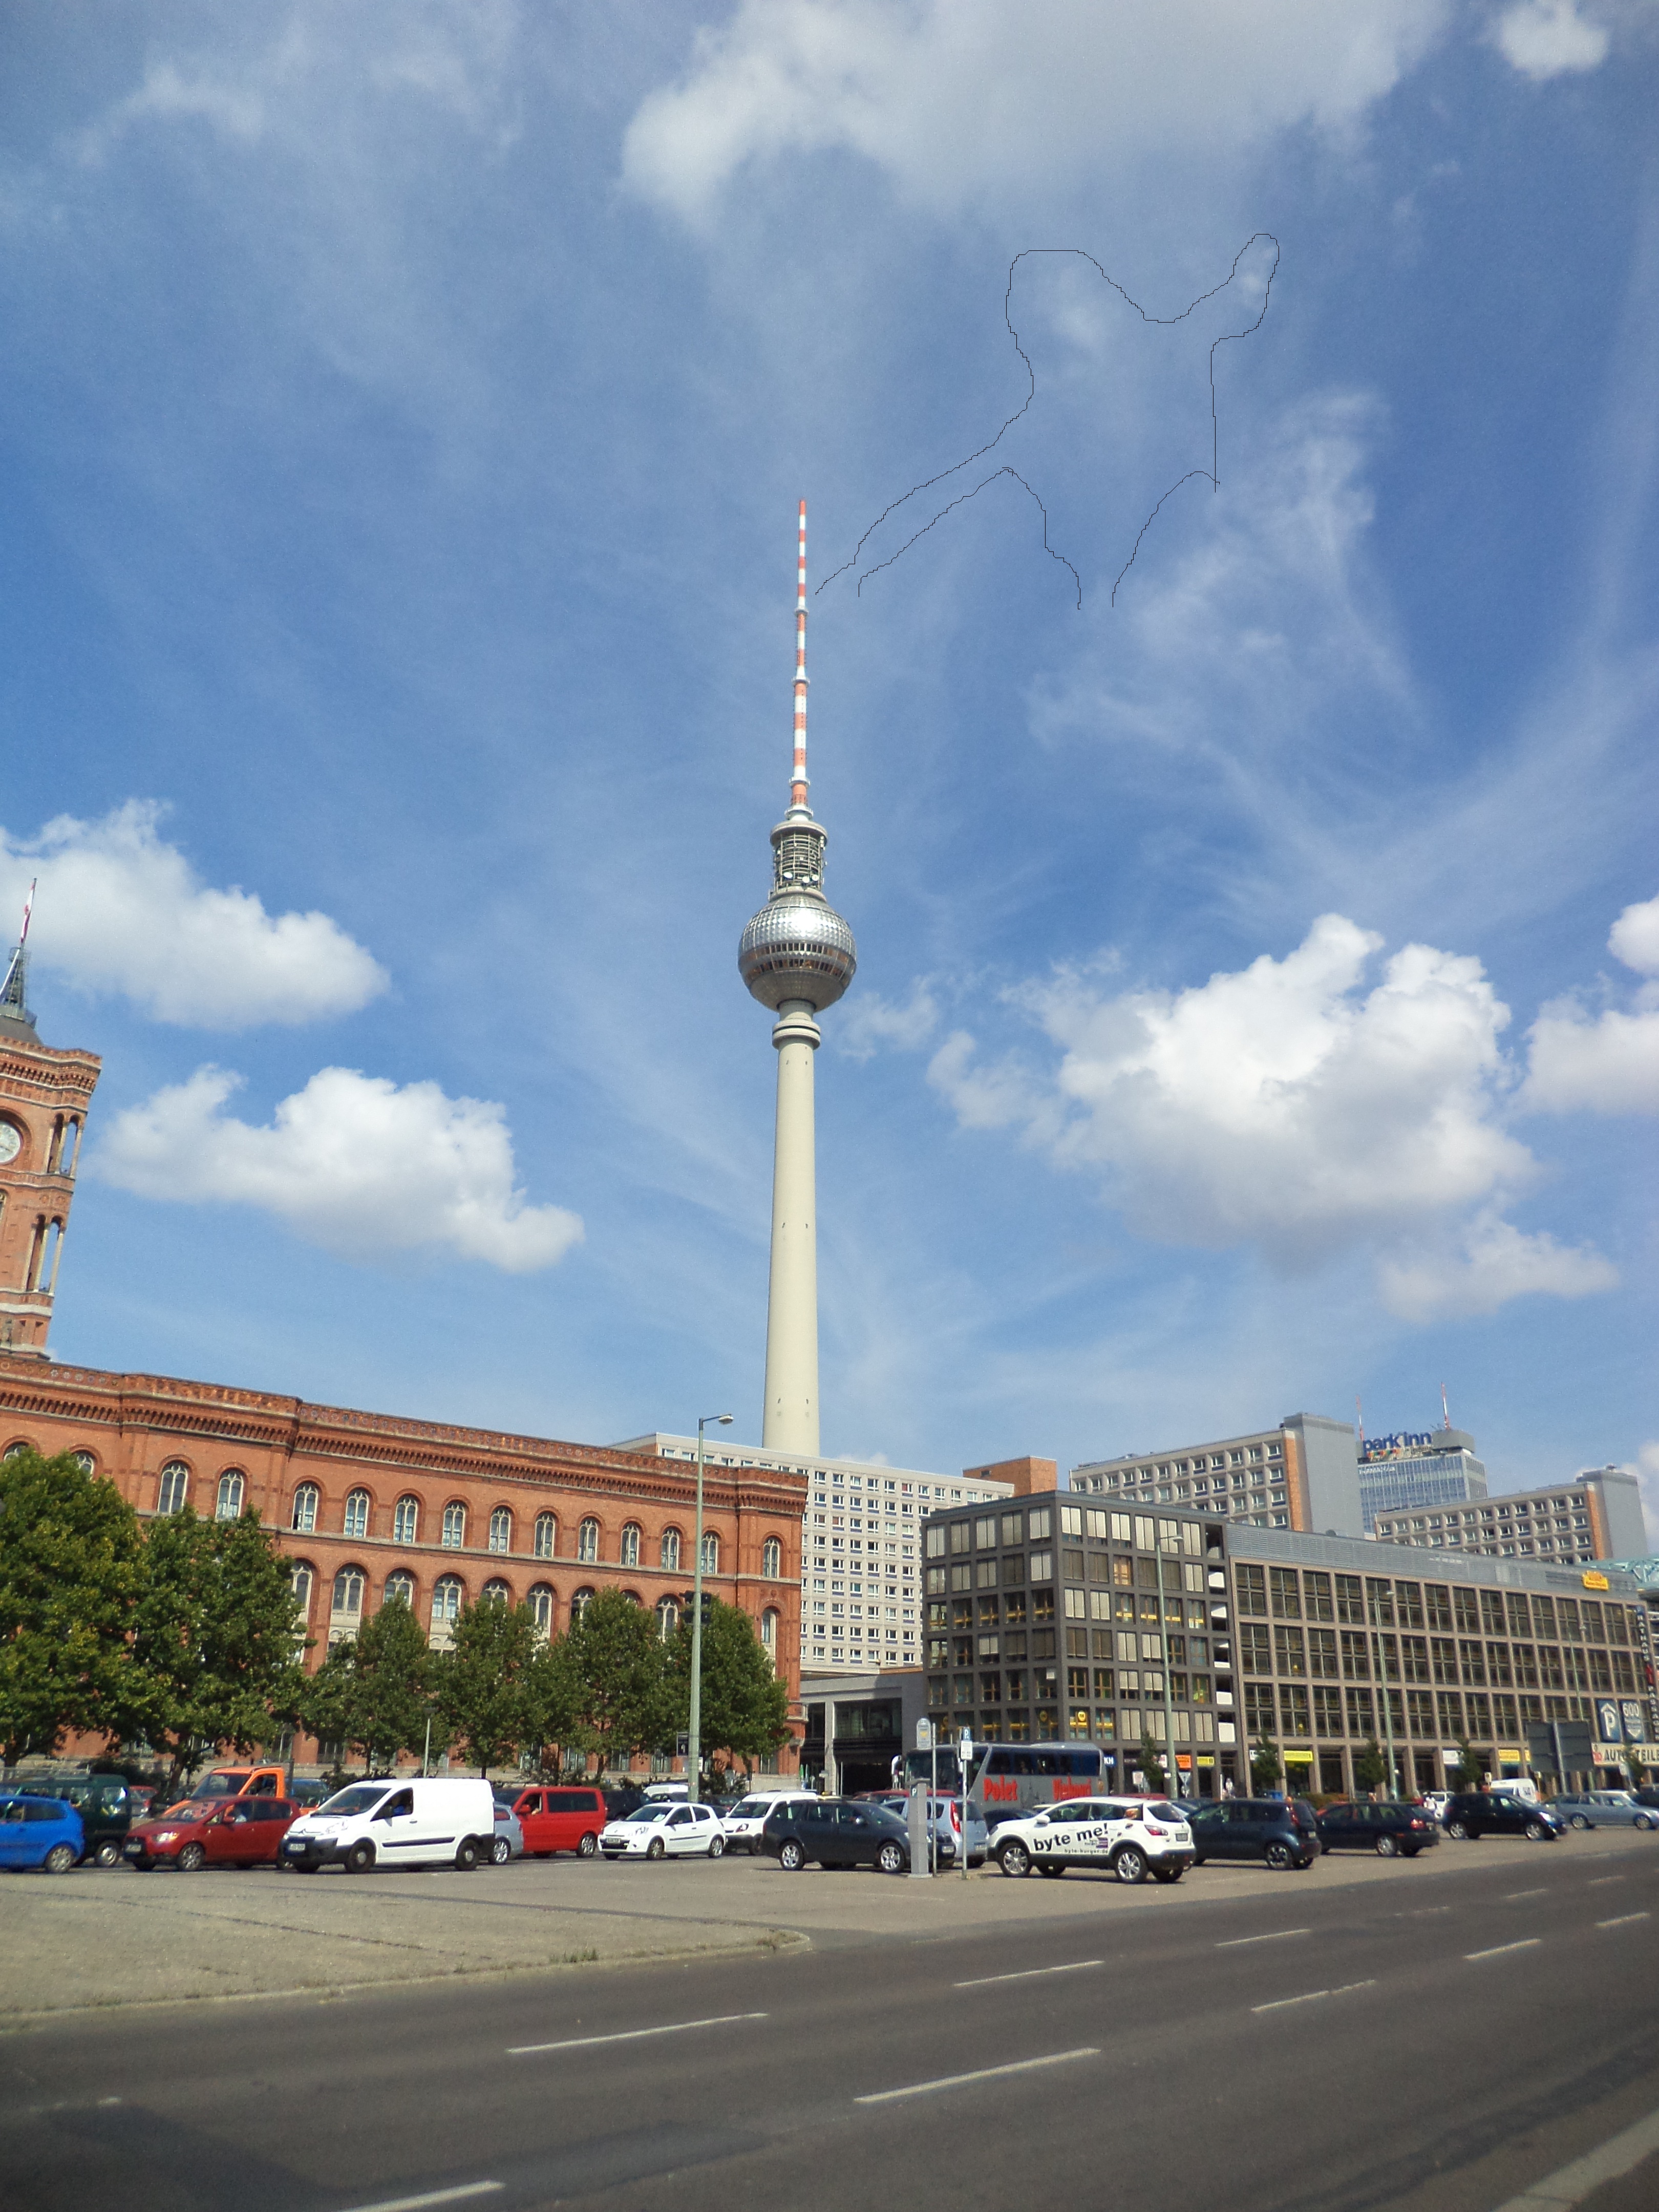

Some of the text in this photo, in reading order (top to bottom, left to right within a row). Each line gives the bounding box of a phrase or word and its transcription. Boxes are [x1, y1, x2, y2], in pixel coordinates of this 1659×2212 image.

[1363, 1433, 1401, 1457] park
[1622, 1703, 1639, 1717] 600
[1604, 1711, 1616, 1737] P
[984, 1775, 1017, 1801] Polet
[1033, 1822, 1109, 1852] byte me!
